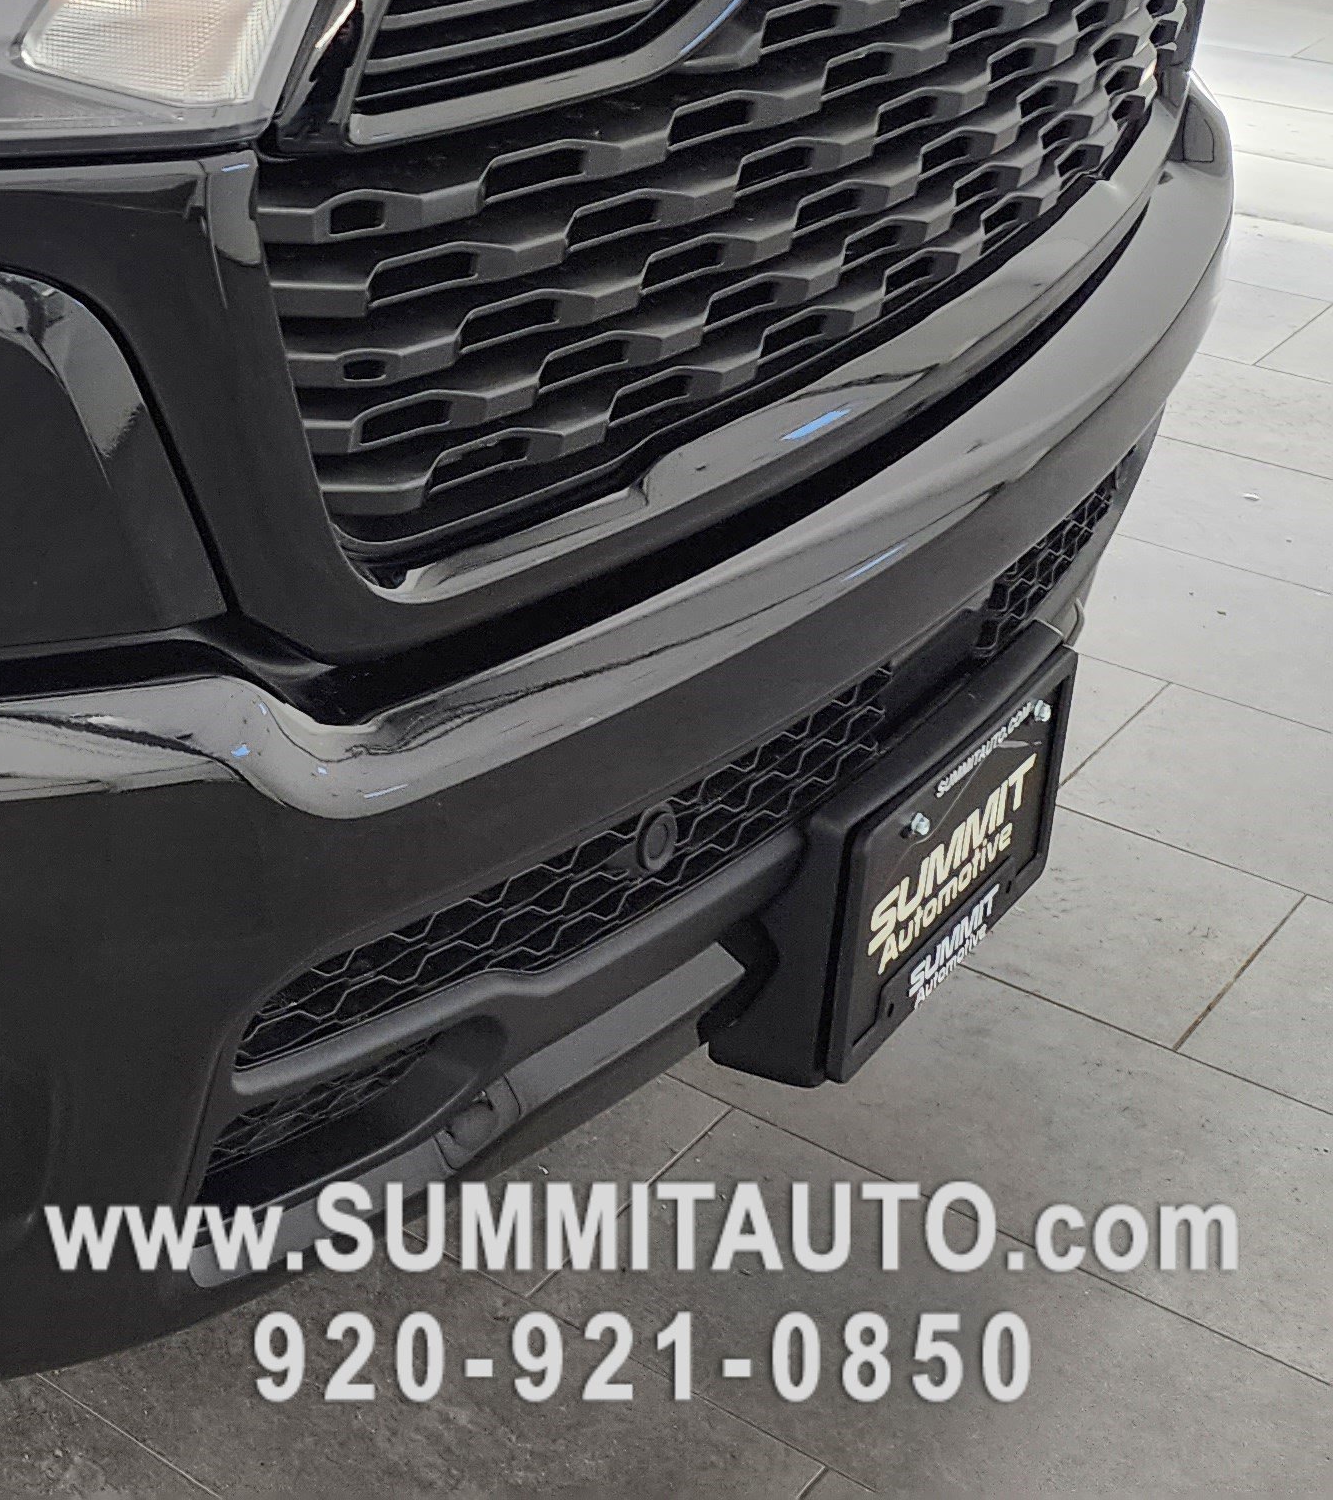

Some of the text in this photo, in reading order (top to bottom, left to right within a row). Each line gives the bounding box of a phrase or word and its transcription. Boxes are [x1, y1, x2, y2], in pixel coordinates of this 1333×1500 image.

[867, 752, 1037, 957] SUMMIT
[878, 821, 1014, 976] Automotive
[908, 883, 1001, 998] SUMMIT
[913, 923, 989, 1011] Automotive
